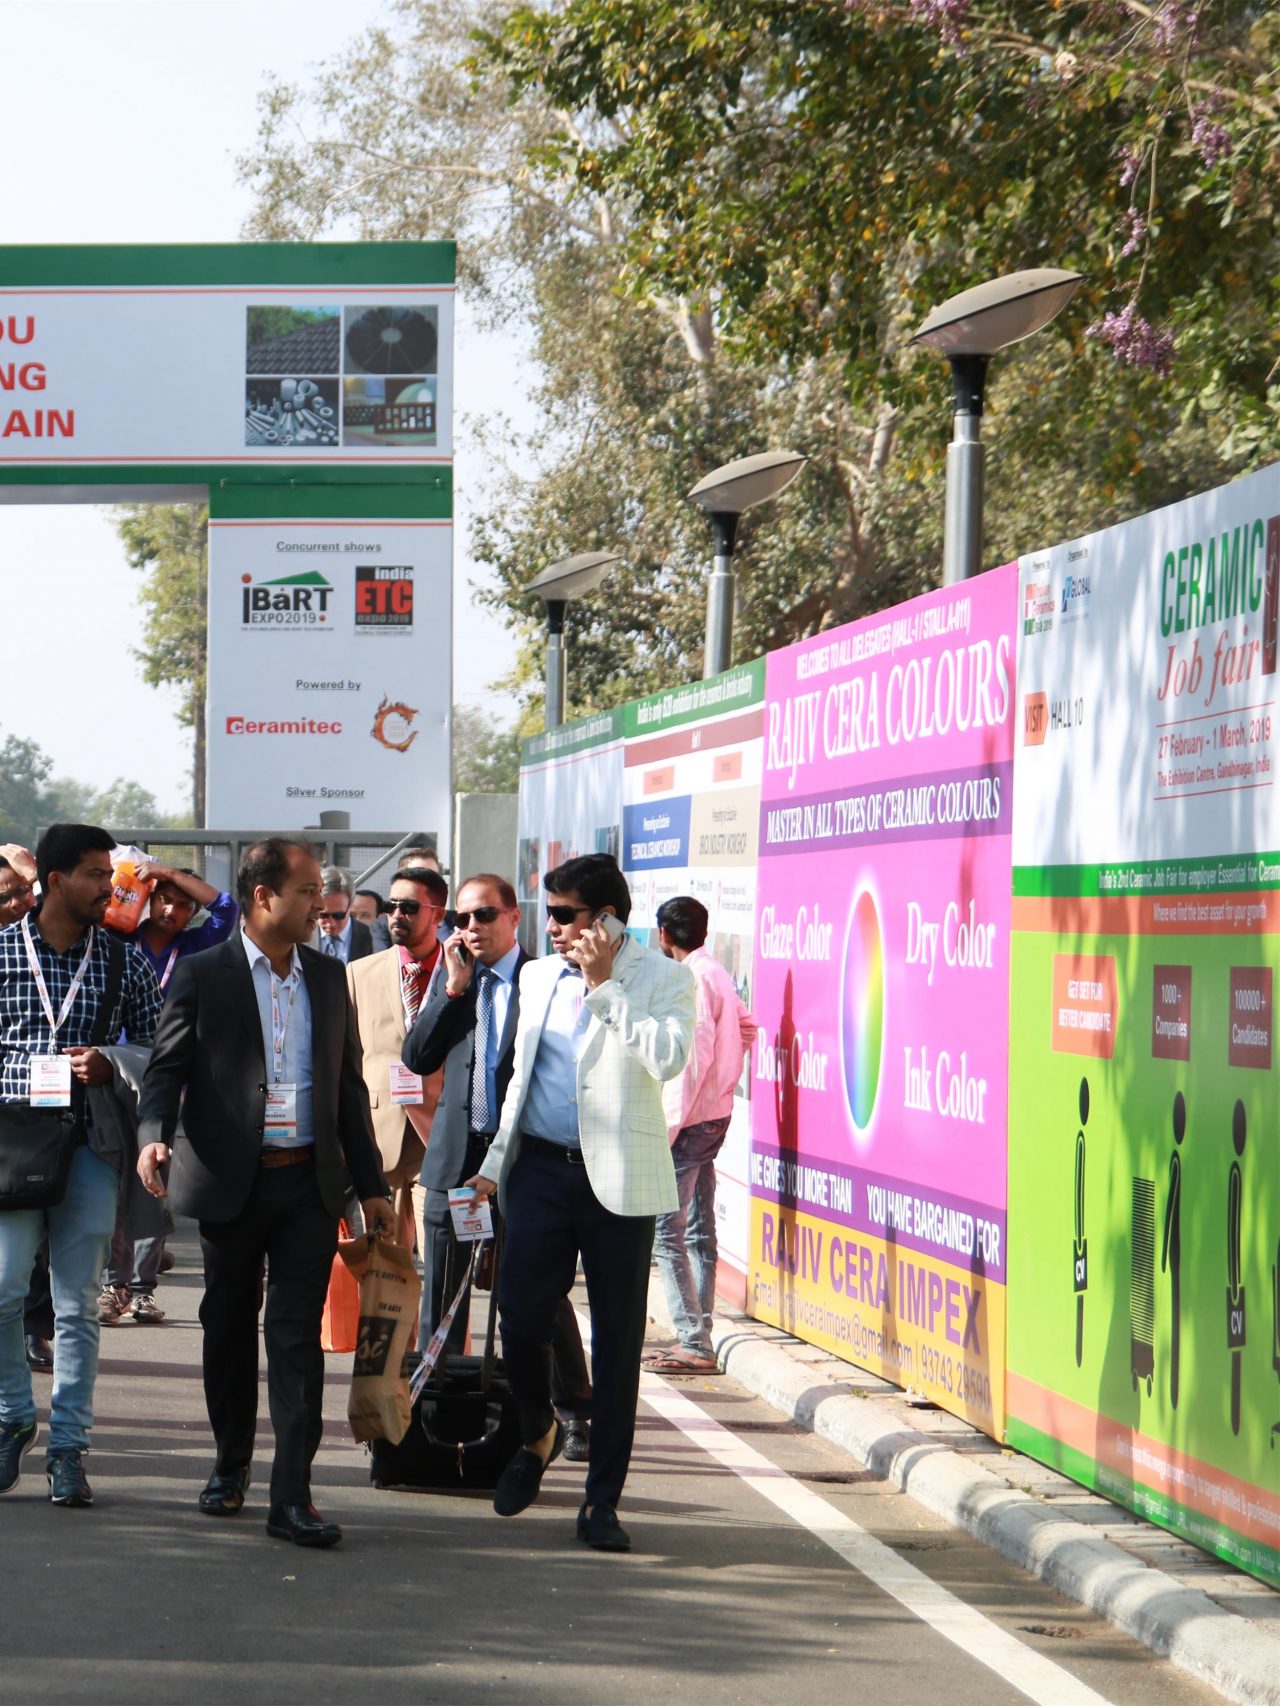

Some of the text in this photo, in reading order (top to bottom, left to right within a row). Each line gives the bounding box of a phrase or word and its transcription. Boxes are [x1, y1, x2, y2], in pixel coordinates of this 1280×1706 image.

[276, 541, 382, 551] Concurrent shows
[374, 566, 413, 580] india
[1160, 518, 1264, 638] CERAMIC
[356, 581, 413, 614] ETC
[252, 613, 316, 624] EXPO2019
[1157, 624, 1260, 706] Job fair
[296, 679, 361, 690] Powered by
[226, 716, 342, 734] Ceramitec
[767, 635, 1009, 790] RAJIV CERA COLOURS
[1024, 697, 1083, 733] VISIT HALL 10
[1158, 736, 1168, 759] 27
[1171, 730, 1204, 761] February
[1220, 721, 1247, 750] March,
[1249, 716, 1271, 744] 2019
[1158, 770, 1166, 787] The
[1168, 766, 1194, 786] Exhibition
[1255, 754, 1269, 773] India
[286, 786, 364, 798] Silver Sponsor
[767, 806, 802, 843] MASTER
[804, 804, 814, 838] IN
[816, 801, 833, 837] ALL
[835, 796, 866, 836] TYPES
[867, 794, 882, 830] OF
[883, 785, 935, 828] CERAMIC
[937, 776, 1000, 824] COLOURS
[1099, 869, 1117, 889] India's
[1130, 868, 1152, 888] Ceramic
[1154, 867, 1165, 887] Job
[1166, 867, 1177, 886] Fair
[1179, 866, 1187, 885] for
[1189, 865, 1216, 889] employer
[1218, 863, 1246, 884] Essential
[1248, 862, 1257, 881] for
[760, 903, 832, 960] Glaze Color
[906, 898, 996, 986] Dry Color
[1068, 980, 1079, 999] GET
[1079, 1010, 1111, 1032] CANDIDATE
[1156, 1016, 1188, 1038] Companies
[1232, 1024, 1268, 1046] Candidates
[792, 1032, 827, 1091] Color
[904, 1046, 987, 1123] Ink Color
[751, 1152, 762, 1186] WE
[787, 1161, 803, 1200] YOU
[804, 1164, 828, 1208] MORE
[829, 1172, 852, 1214] THAN
[866, 1184, 886, 1226] YOU
[888, 1191, 912, 1234] HAVE
[914, 1199, 974, 1256] BARGAINED
[976, 1218, 1000, 1266] FOR
[762, 1212, 981, 1356] RAJIV CERA IMPEX
[1075, 1257, 1086, 1282] CV
[1230, 1310, 1243, 1336] CV
[921, 1343, 953, 1394] 93743
